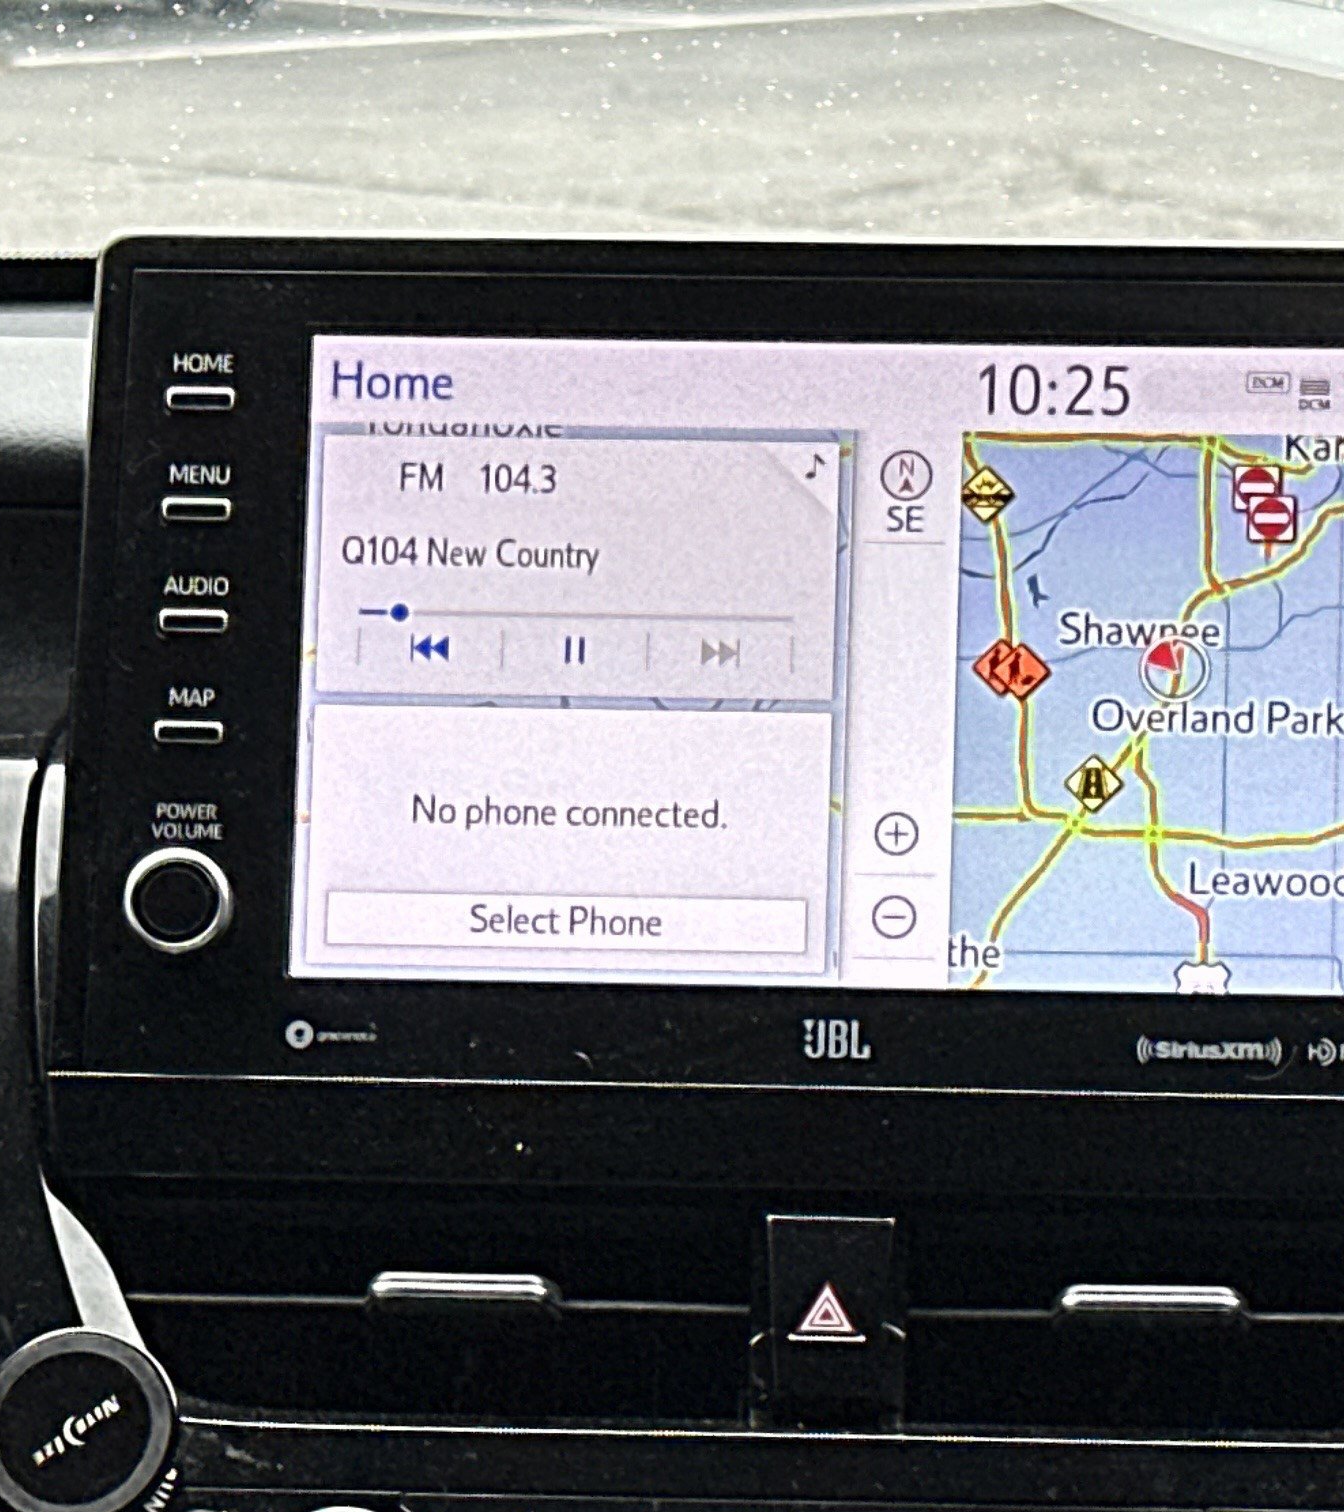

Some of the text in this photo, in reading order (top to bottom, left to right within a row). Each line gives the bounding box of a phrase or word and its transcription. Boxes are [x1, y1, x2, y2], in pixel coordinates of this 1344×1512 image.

[173, 353, 234, 374] HOME
[331, 360, 454, 400] Home
[977, 364, 1131, 417] 10:25
[169, 465, 231, 485] MENU
[400, 463, 558, 495] FM 104.3
[899, 457, 916, 478] N
[887, 506, 924, 534] SE
[341, 536, 600, 576] Q104 New Country
[164, 575, 229, 596] AUDIO
[1060, 612, 1221, 647] Shawnee
[168, 688, 216, 708] MAP
[1092, 702, 1254, 735] Overland
[156, 803, 218, 820] POWER
[412, 795, 728, 832] No phone connected.
[151, 822, 224, 842] VOLUME
[469, 905, 663, 938] Select Phone
[803, 1019, 871, 1060] JBL
